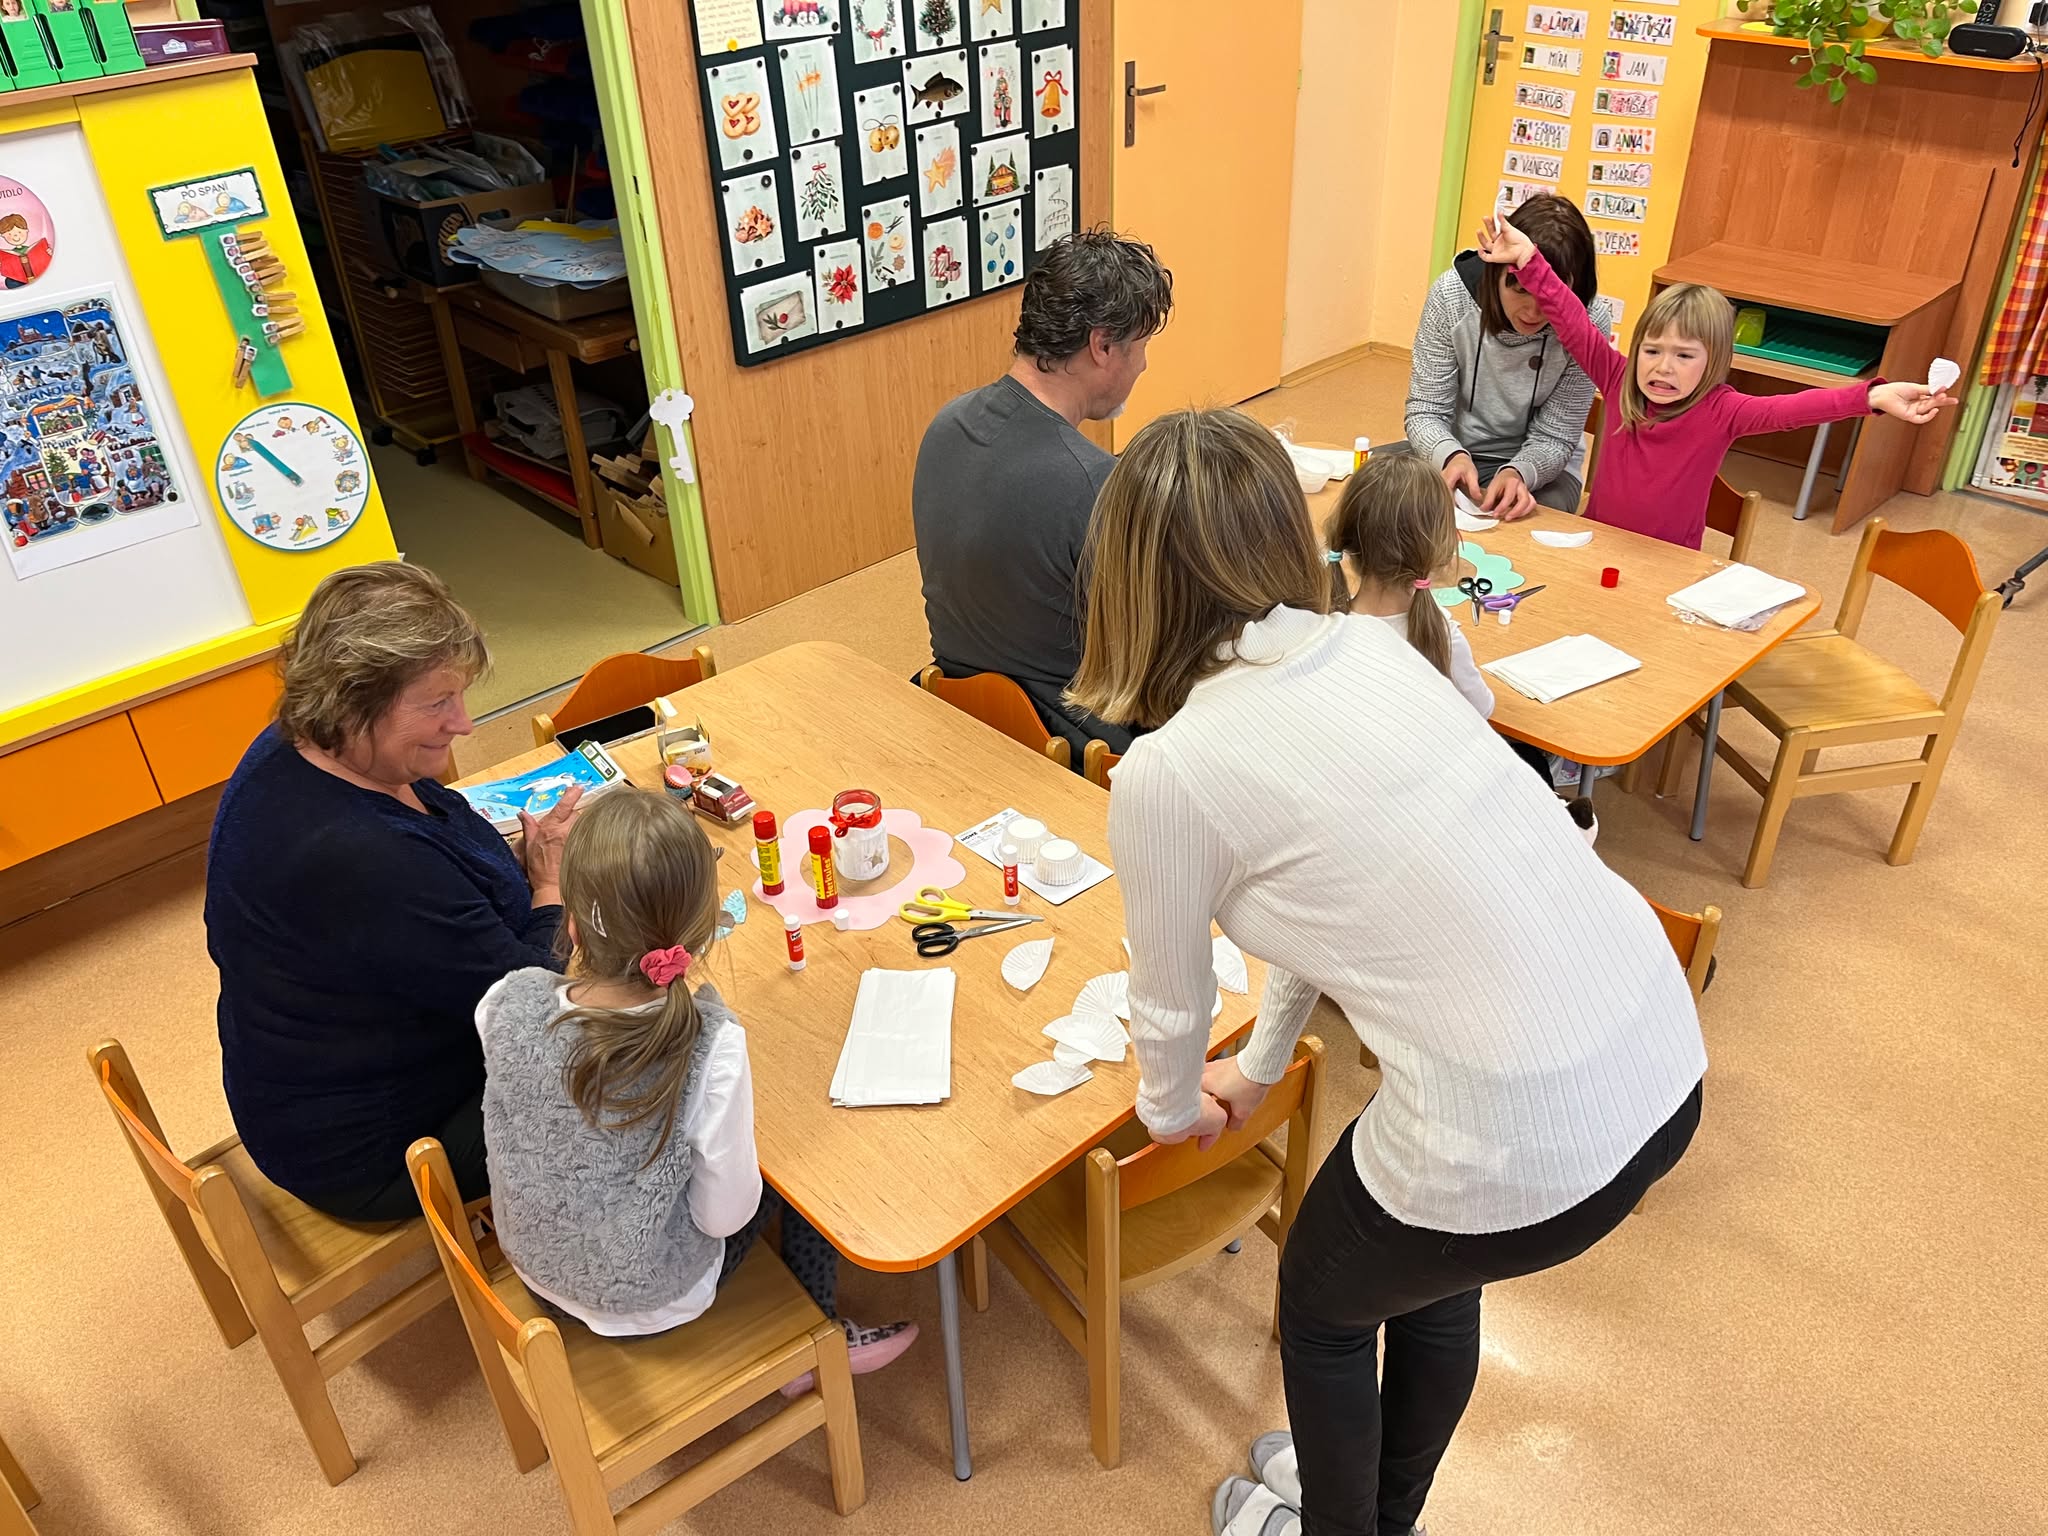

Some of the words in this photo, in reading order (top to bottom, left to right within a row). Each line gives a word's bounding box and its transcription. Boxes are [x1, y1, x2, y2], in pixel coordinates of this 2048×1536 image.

[1626, 61, 1648, 76] JAN
[1615, 133, 1643, 148] ANNA
[1522, 159, 1560, 178] VANESSA
[1609, 168, 1638, 182] MARIE
[180, 188, 197, 199] PO
